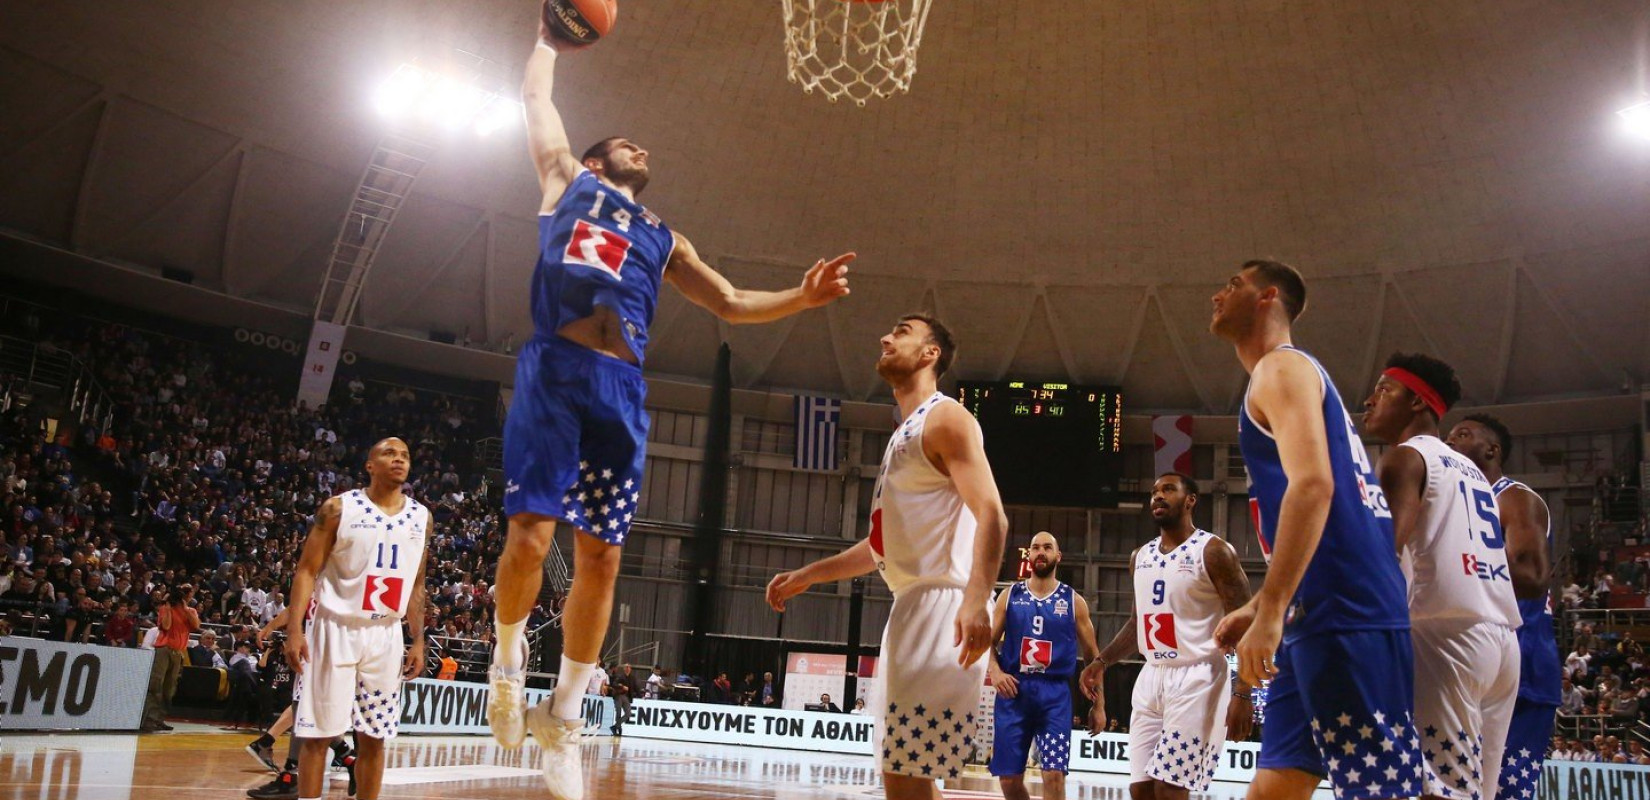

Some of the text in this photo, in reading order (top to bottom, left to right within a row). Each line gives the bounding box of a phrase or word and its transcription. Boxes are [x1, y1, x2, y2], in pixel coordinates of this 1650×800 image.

[588, 190, 632, 232] 14
[1459, 479, 1505, 549] 15
[376, 542, 398, 569] 11
[1476, 561, 1510, 581] EK
[1152, 580, 1165, 605] 9
[1032, 615, 1044, 635] 9
[1154, 651, 1178, 659] EKO
[625, 705, 756, 734] ΕΝΙΣΧΥΟΥΜΕ
[763, 716, 804, 737] ΤΟΝ
[1226, 749, 1261, 770] ΤΟ
[1567, 766, 1650, 800] ΑΘΛΗΤΙ
